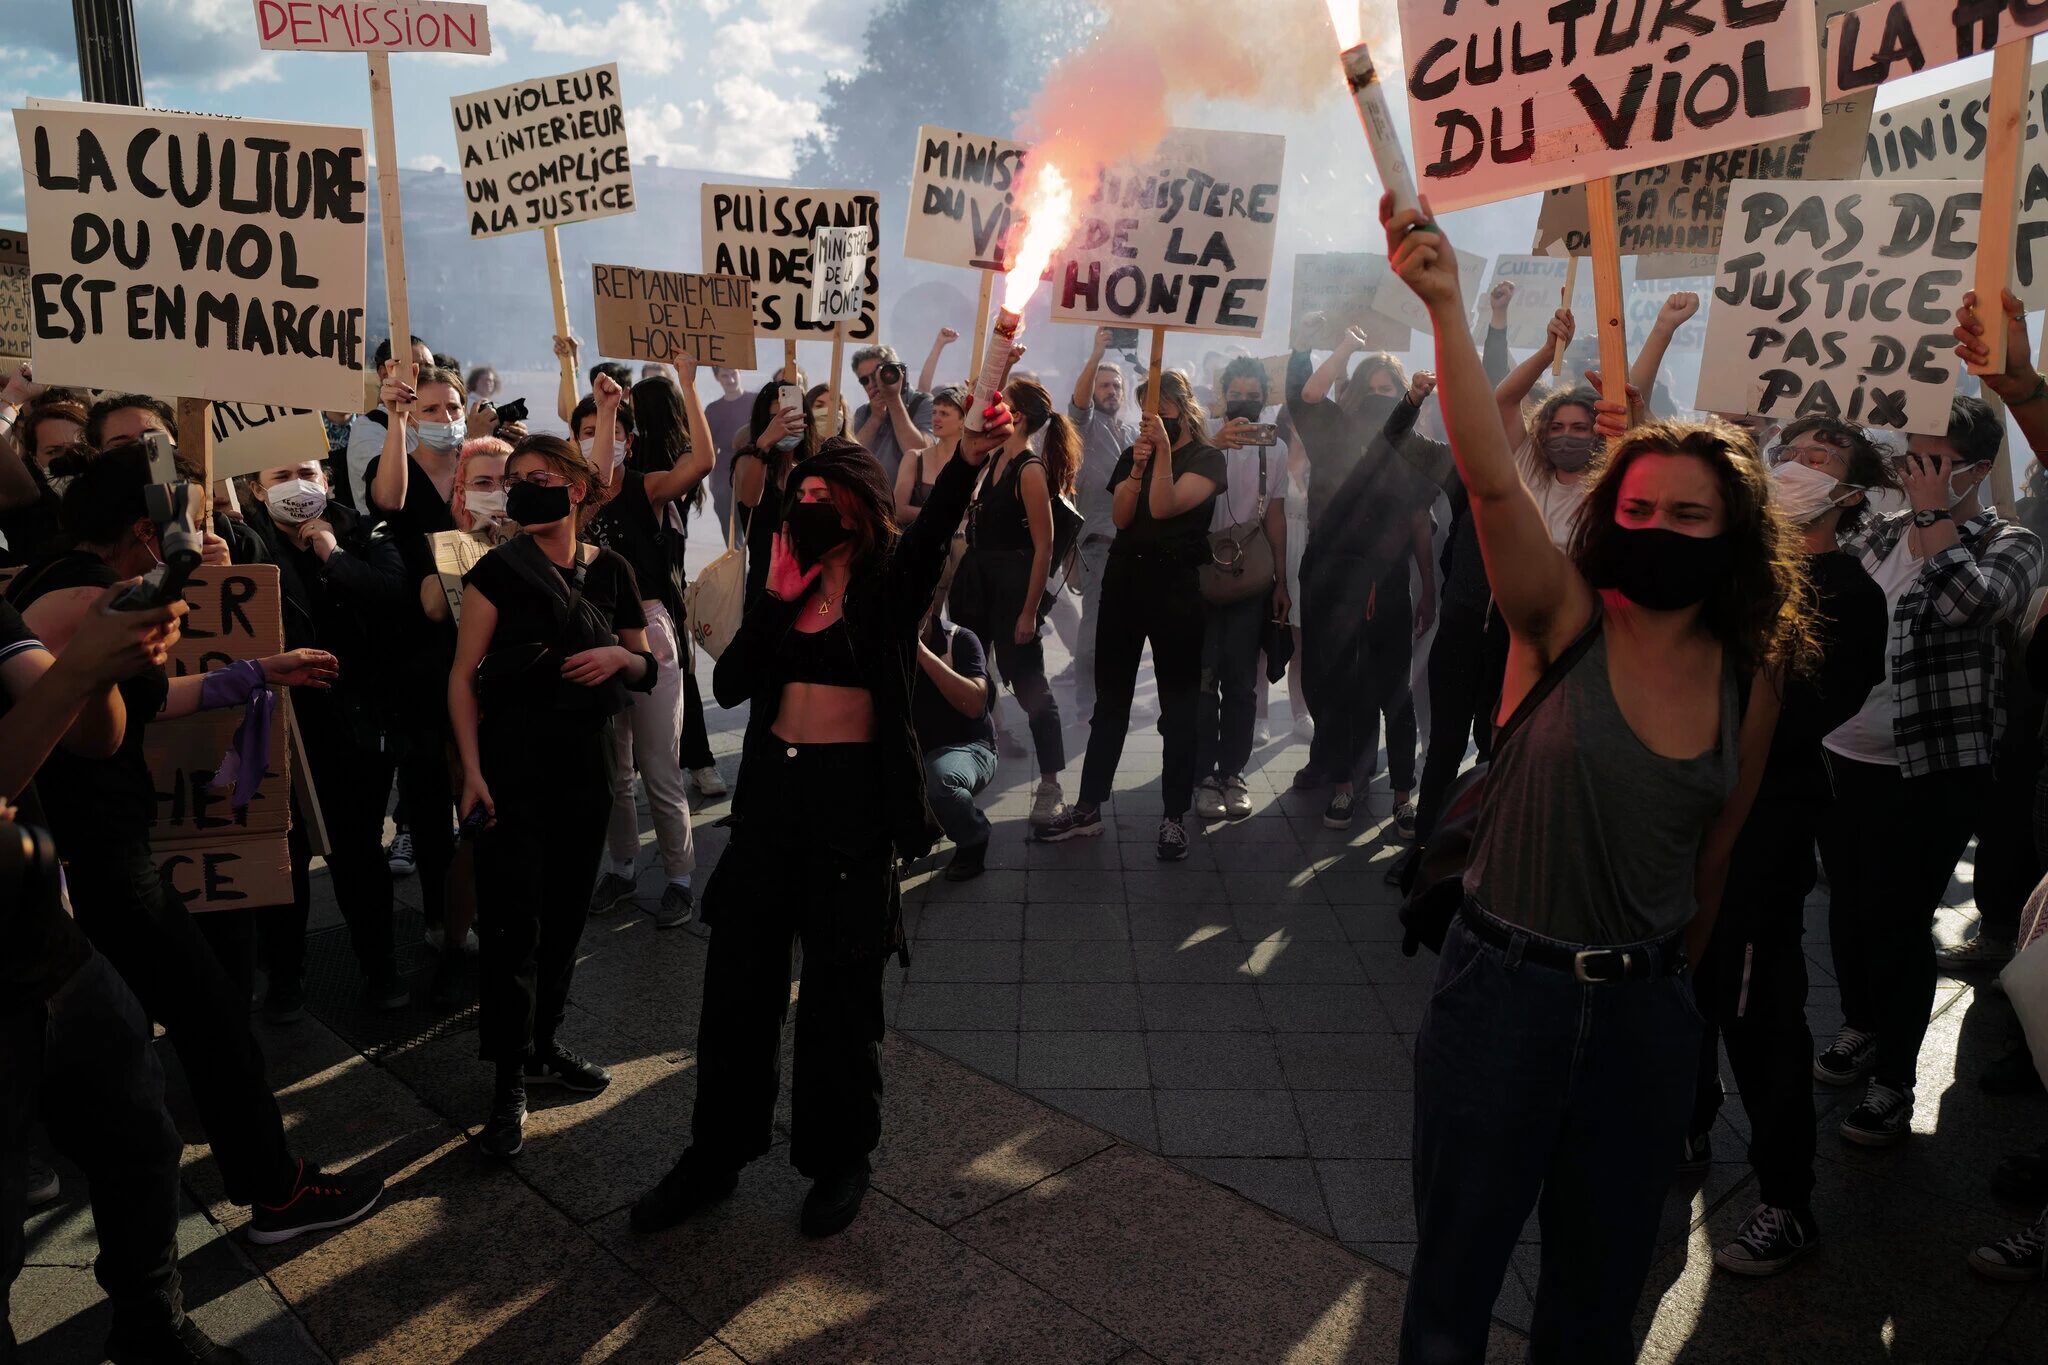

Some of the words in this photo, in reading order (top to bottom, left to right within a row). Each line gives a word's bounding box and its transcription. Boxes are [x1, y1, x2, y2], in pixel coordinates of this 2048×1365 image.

[1837, 1, 1925, 91] LA
[454, 101, 492, 132] UN
[1423, 98, 1536, 179] DU
[35, 125, 118, 194] LA
[127, 127, 366, 224] CULTURE
[464, 144, 483, 168] A
[465, 178, 500, 203] UN
[923, 184, 965, 221] DU
[713, 189, 880, 251] PUISSANTS
[1741, 192, 1864, 262] PAS
[1877, 192, 1984, 260] DE
[70, 212, 151, 271] DU
[171, 222, 319, 289] VIOL
[716, 242, 760, 283] AU
[1077, 218, 1139, 259] DE
[1164, 227, 1237, 272] LA
[594, 265, 751, 308] REMANIEMENT
[825, 266, 841, 285] DE
[1061, 260, 1267, 328] HONTE
[31, 273, 117, 344] EST
[127, 284, 187, 340] EN
[195, 290, 364, 370] MARCHE
[649, 303, 679, 328] DE
[684, 306, 716, 330] LA
[818, 286, 860, 315] HONTE
[629, 325, 726, 363] HONTE
[1746, 326, 1849, 370] PAS
[1861, 334, 1959, 384] DE
